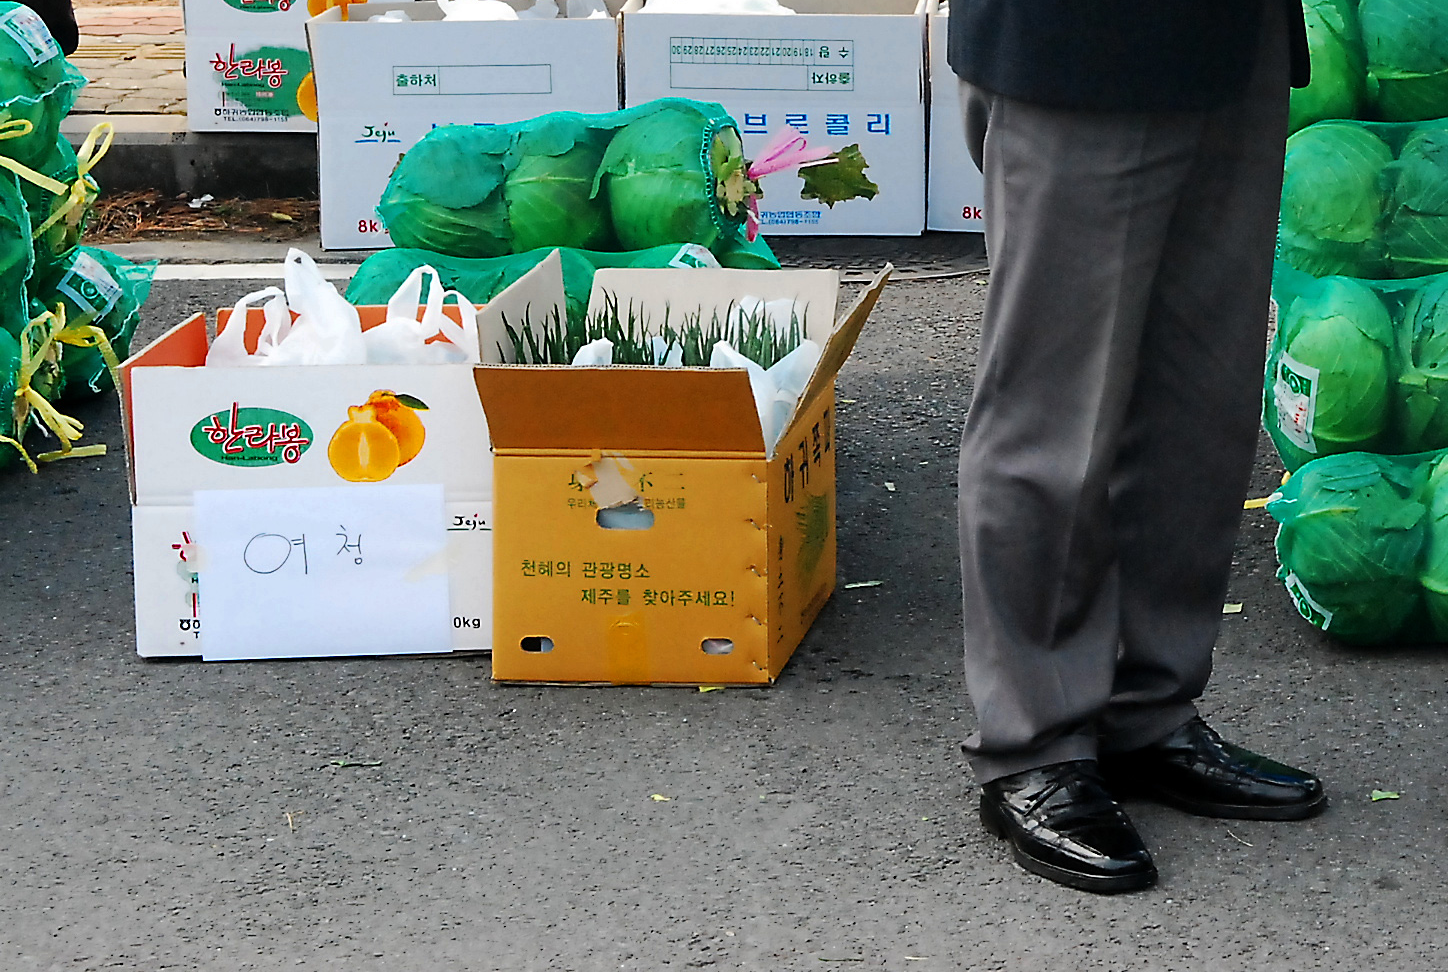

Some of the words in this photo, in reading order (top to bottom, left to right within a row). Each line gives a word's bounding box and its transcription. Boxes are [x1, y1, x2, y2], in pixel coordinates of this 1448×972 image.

[209, 42, 289, 87] 한라봉
[396, 74, 437, 87] 출하처
[812, 72, 850, 84] 출하자
[361, 121, 396, 143] Jeju
[743, 113, 890, 135] 브로콜리
[962, 206, 983, 219] 8k
[357, 220, 389, 234] 8k
[202, 401, 310, 464] 한라봉
[645, 497, 685, 509] 리농산물
[452, 513, 487, 531] Jeju
[521, 559, 571, 578] 천혜의
[581, 561, 651, 579] 관광명소
[581, 588, 631, 606] 제주를
[643, 589, 735, 607] 찾아주세요!
[453, 616, 481, 629] 0kg
